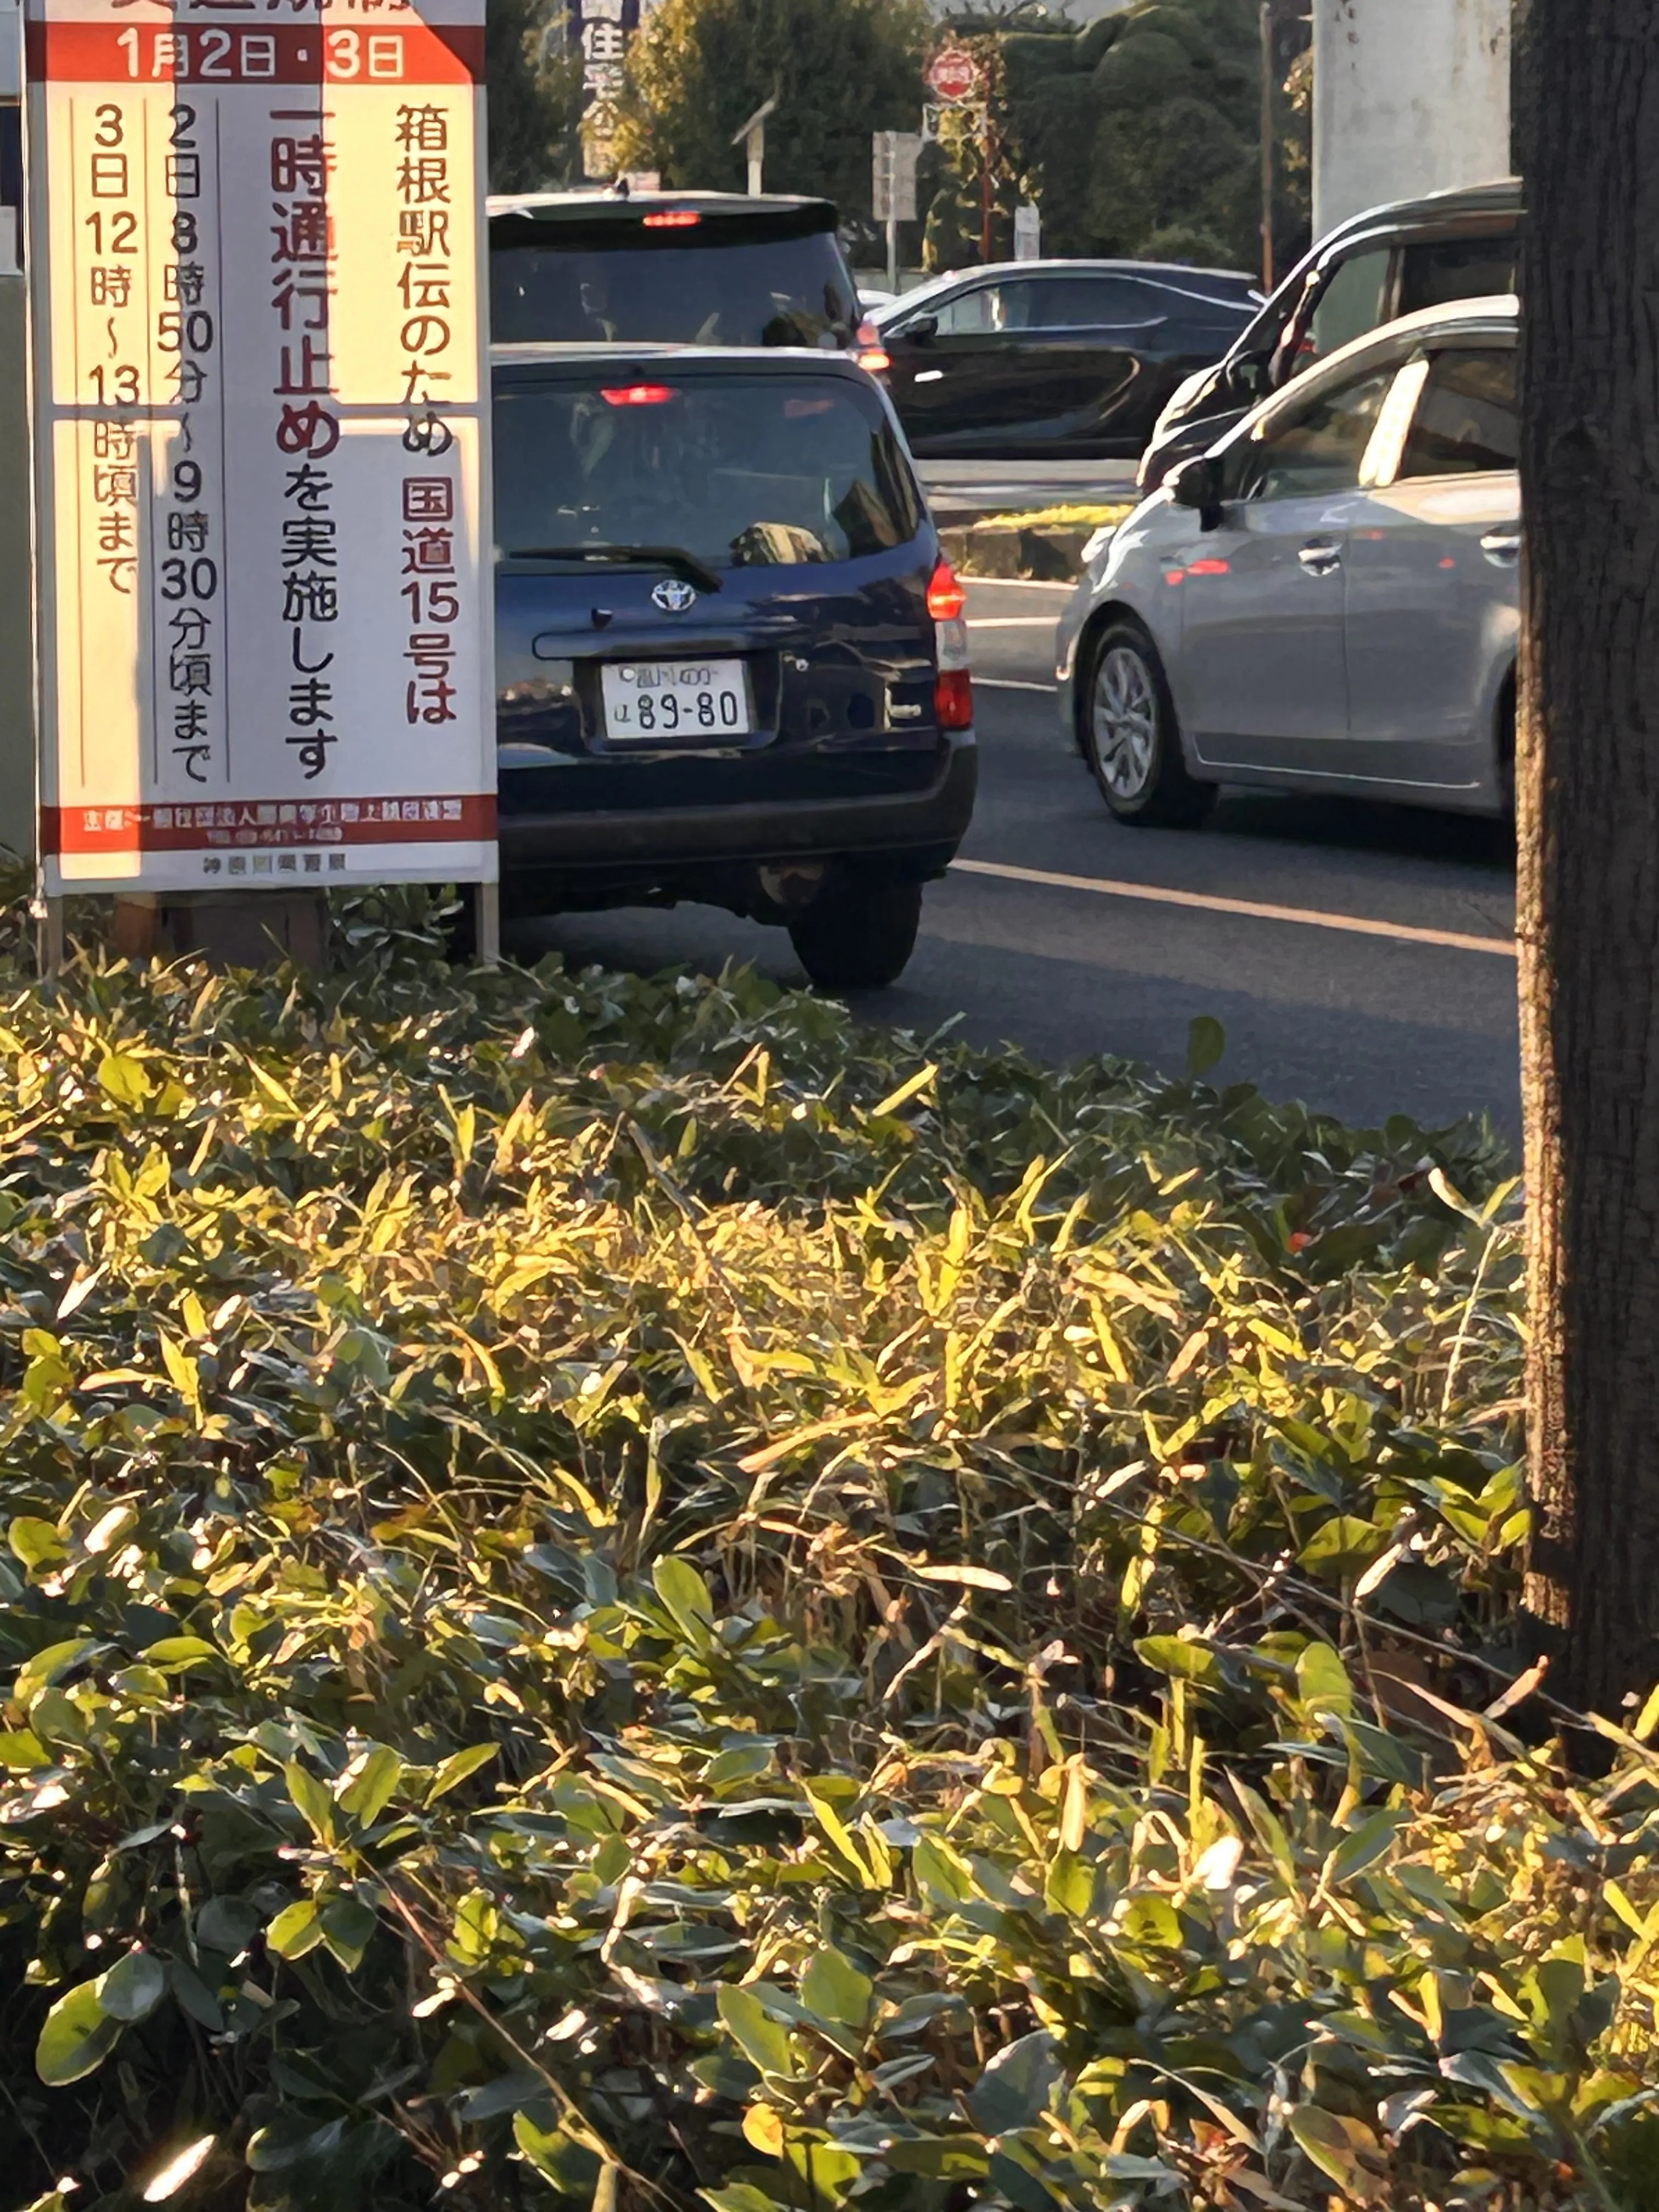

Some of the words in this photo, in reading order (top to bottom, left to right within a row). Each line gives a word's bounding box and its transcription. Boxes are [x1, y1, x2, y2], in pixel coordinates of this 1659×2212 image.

[117, 27, 404, 78] 1月2日・3日
[395, 104, 453, 456] 箱根駅伝のため
[270, 110, 338, 780] 一時通行止めを実施します
[400, 476, 459, 724] 国道15号は
[637, 691, 737, 730] 89-80
